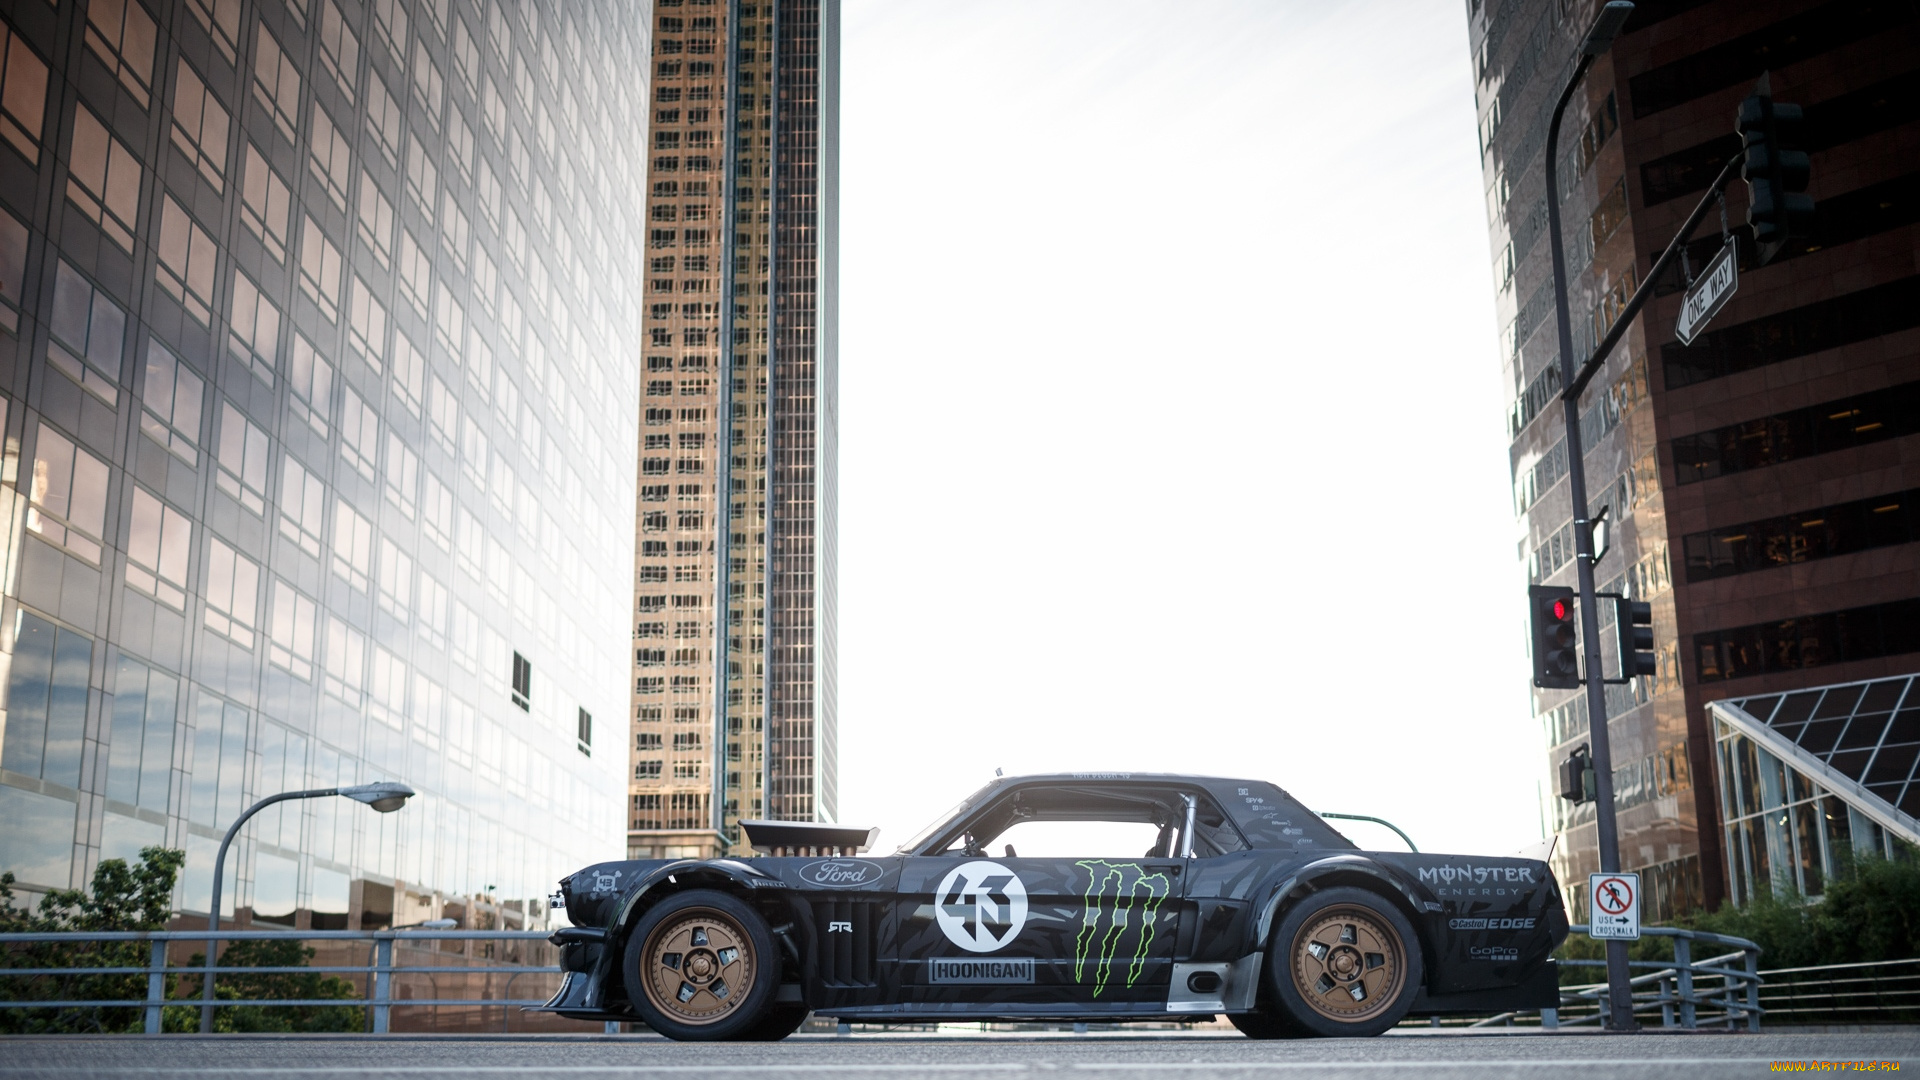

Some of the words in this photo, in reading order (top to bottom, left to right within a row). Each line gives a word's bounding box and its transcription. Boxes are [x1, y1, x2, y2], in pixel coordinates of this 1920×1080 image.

[1687, 288, 1705, 325] ONE
[1710, 259, 1729, 301] WAY
[815, 862, 866, 883] Ford
[1418, 864, 1535, 885] MONSTER
[599, 878, 613, 887] 43
[1438, 888, 1519, 896] ENERGY
[942, 873, 1015, 943] 43
[1458, 918, 1485, 928] Castrol
[1487, 917, 1536, 930] EDGE
[1598, 916, 1614, 924] USE
[1595, 926, 1634, 935] CROSSWALK
[1470, 946, 1518, 955] GoPro
